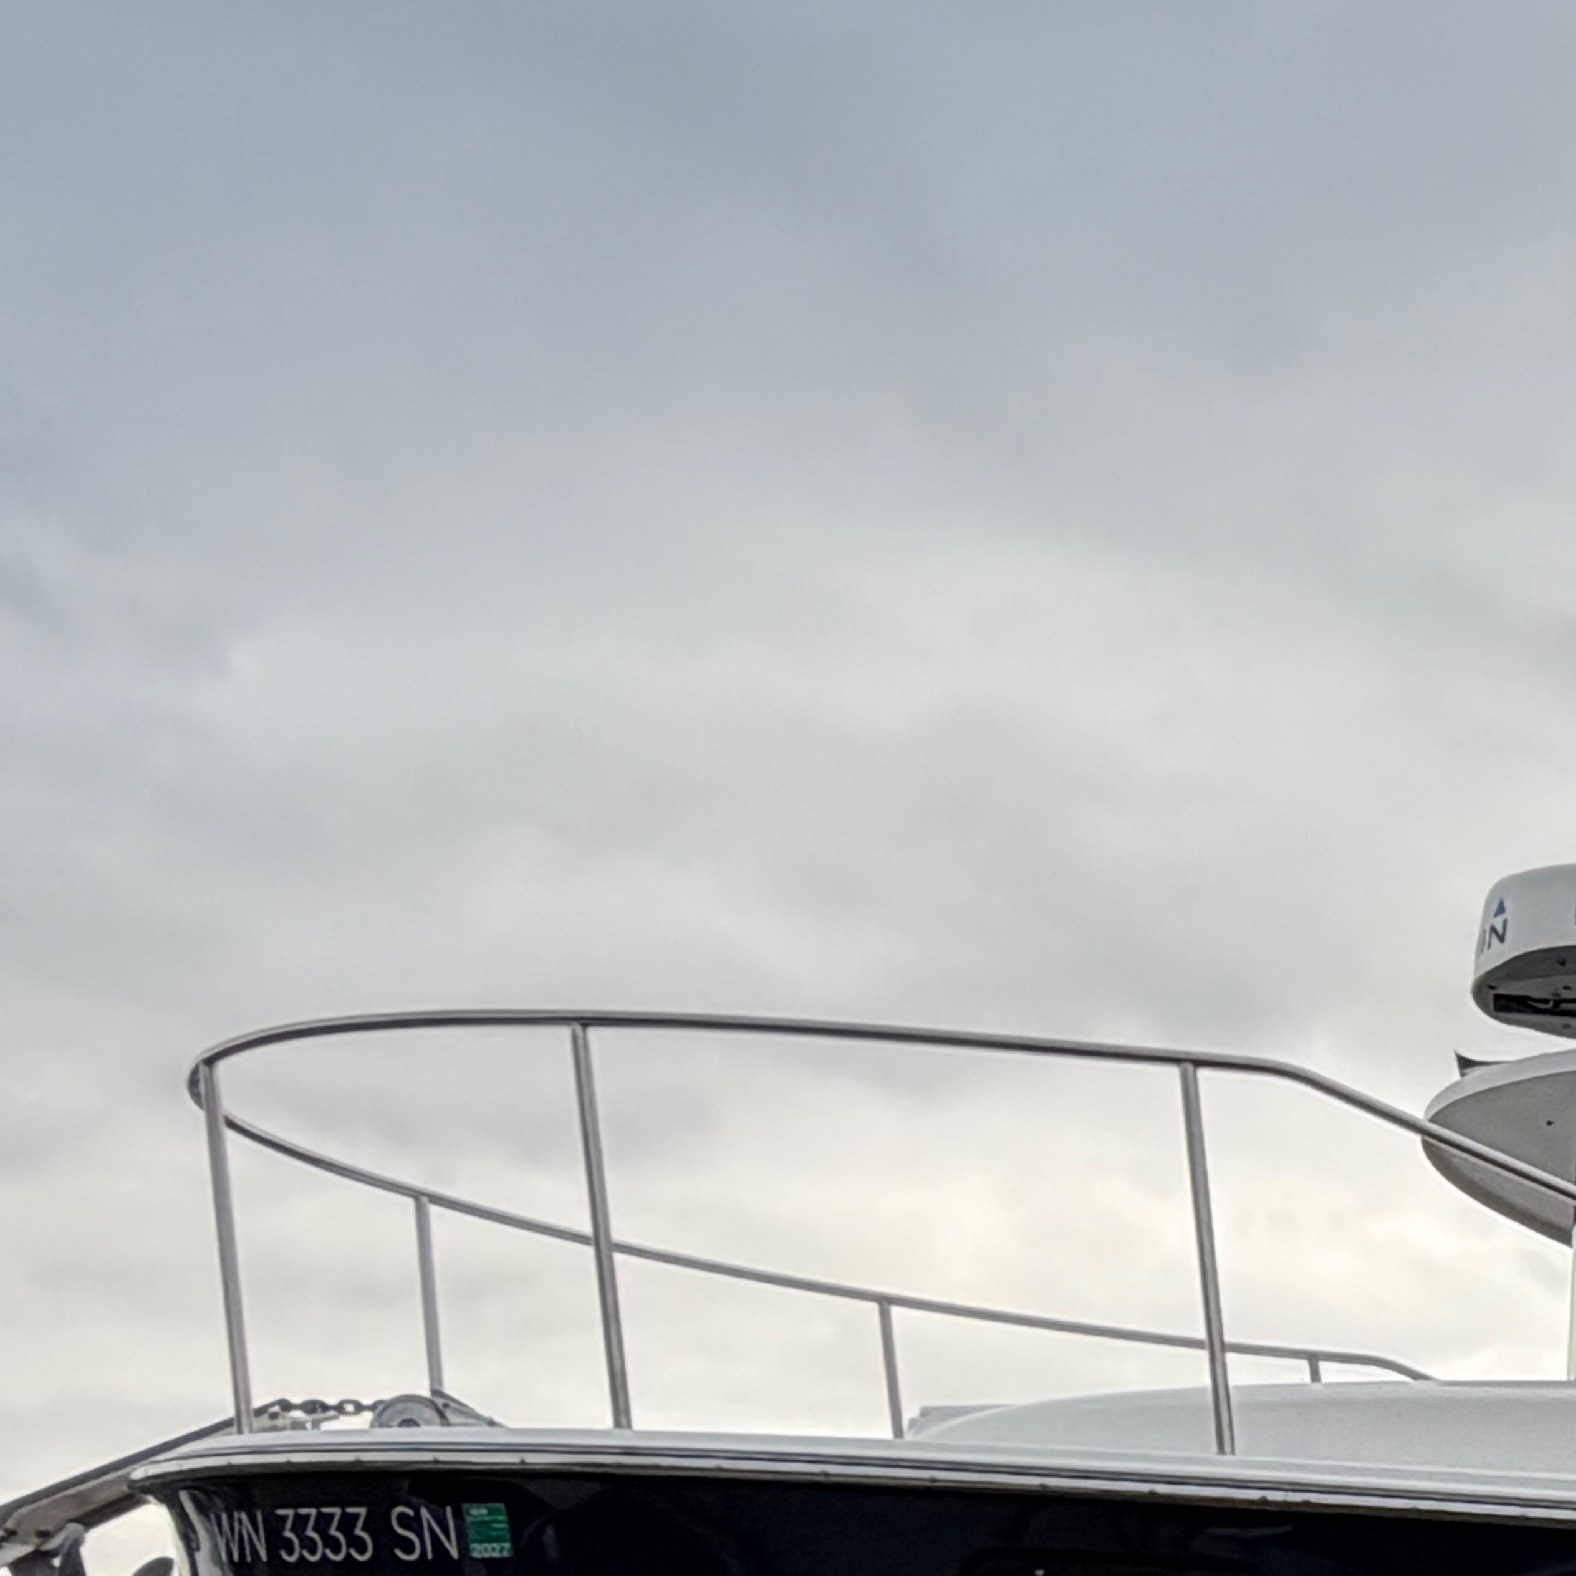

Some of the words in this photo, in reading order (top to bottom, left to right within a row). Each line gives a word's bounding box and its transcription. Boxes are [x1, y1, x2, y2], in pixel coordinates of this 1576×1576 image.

[209, 1510, 267, 1562] WN
[275, 1508, 373, 1562] 3333
[390, 1505, 459, 1562] SN
